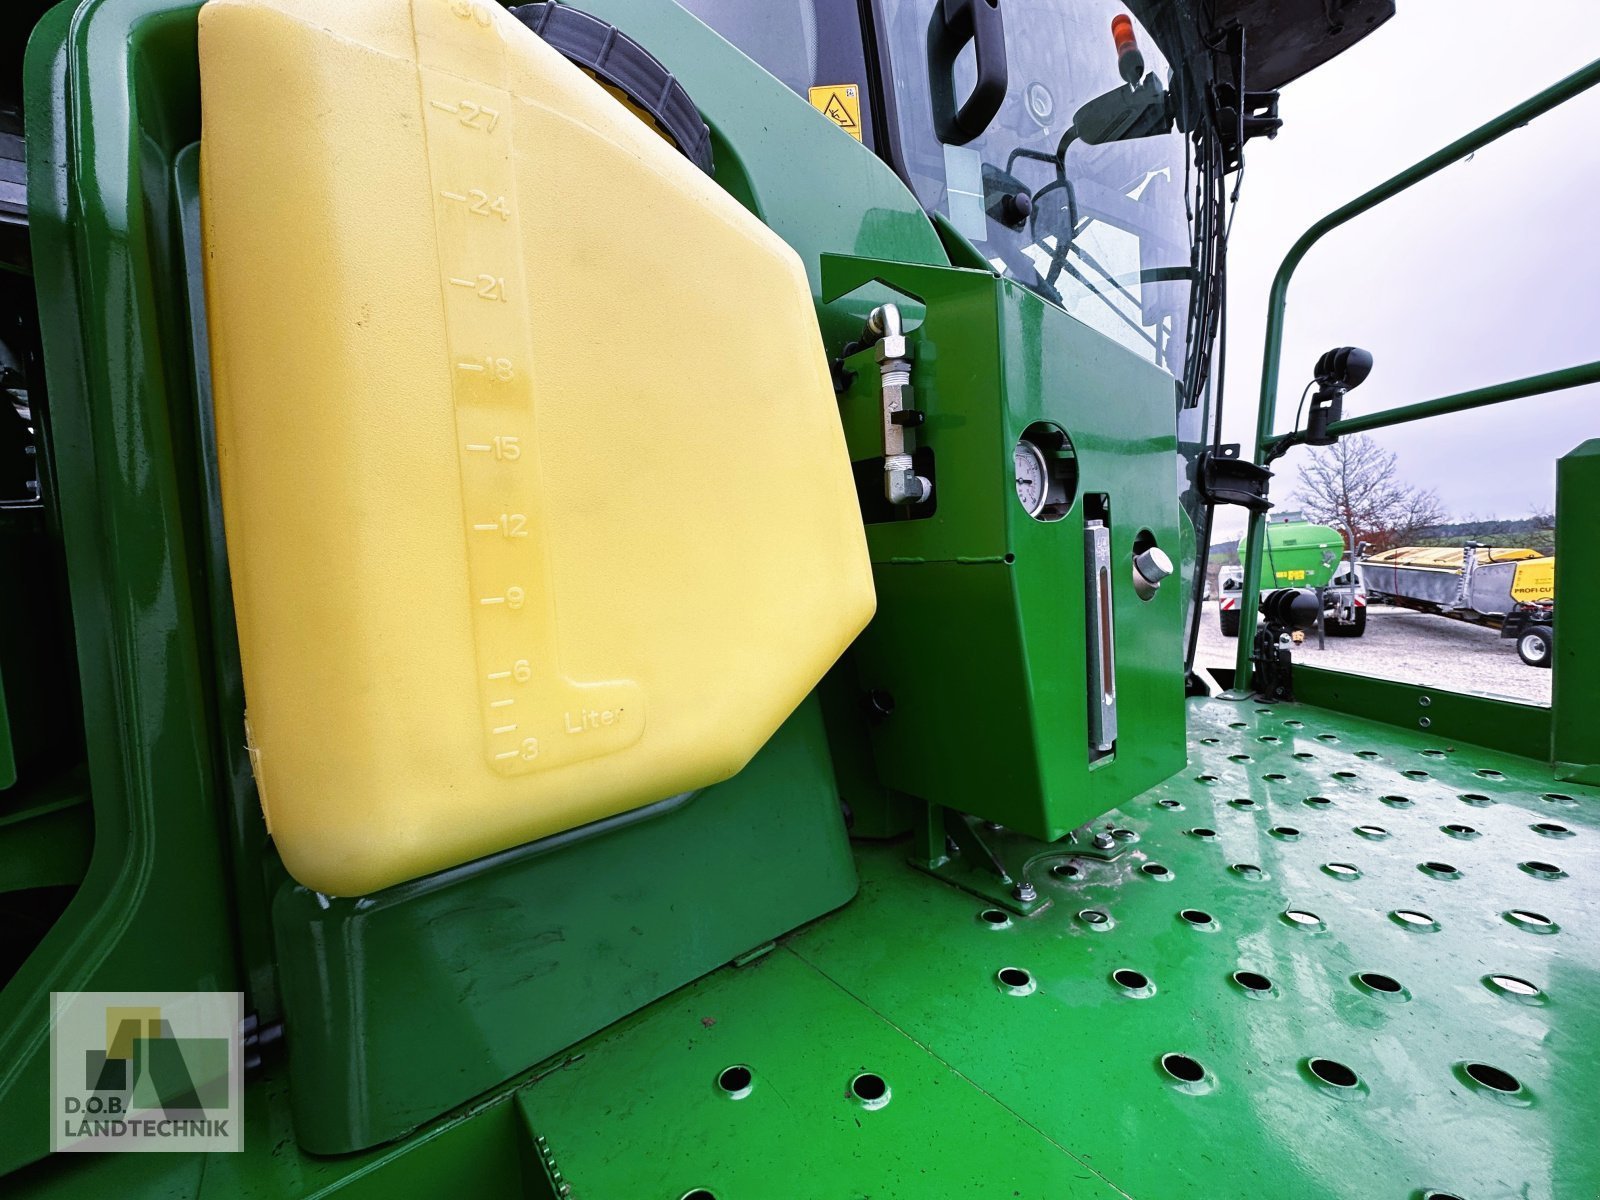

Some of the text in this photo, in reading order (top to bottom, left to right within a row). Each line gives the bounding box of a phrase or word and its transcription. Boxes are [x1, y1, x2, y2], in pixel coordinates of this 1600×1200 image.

[458, 100, 499, 134] 27
[468, 189, 511, 221] 24
[477, 274, 507, 302] 21
[485, 356, 514, 382] 18
[493, 435, 521, 461] 15
[500, 513, 528, 538] 12
[506, 586, 525, 610] 9
[513, 659, 531, 683] 6
[564, 706, 624, 734] Liter
[521, 737, 538, 761] 3
